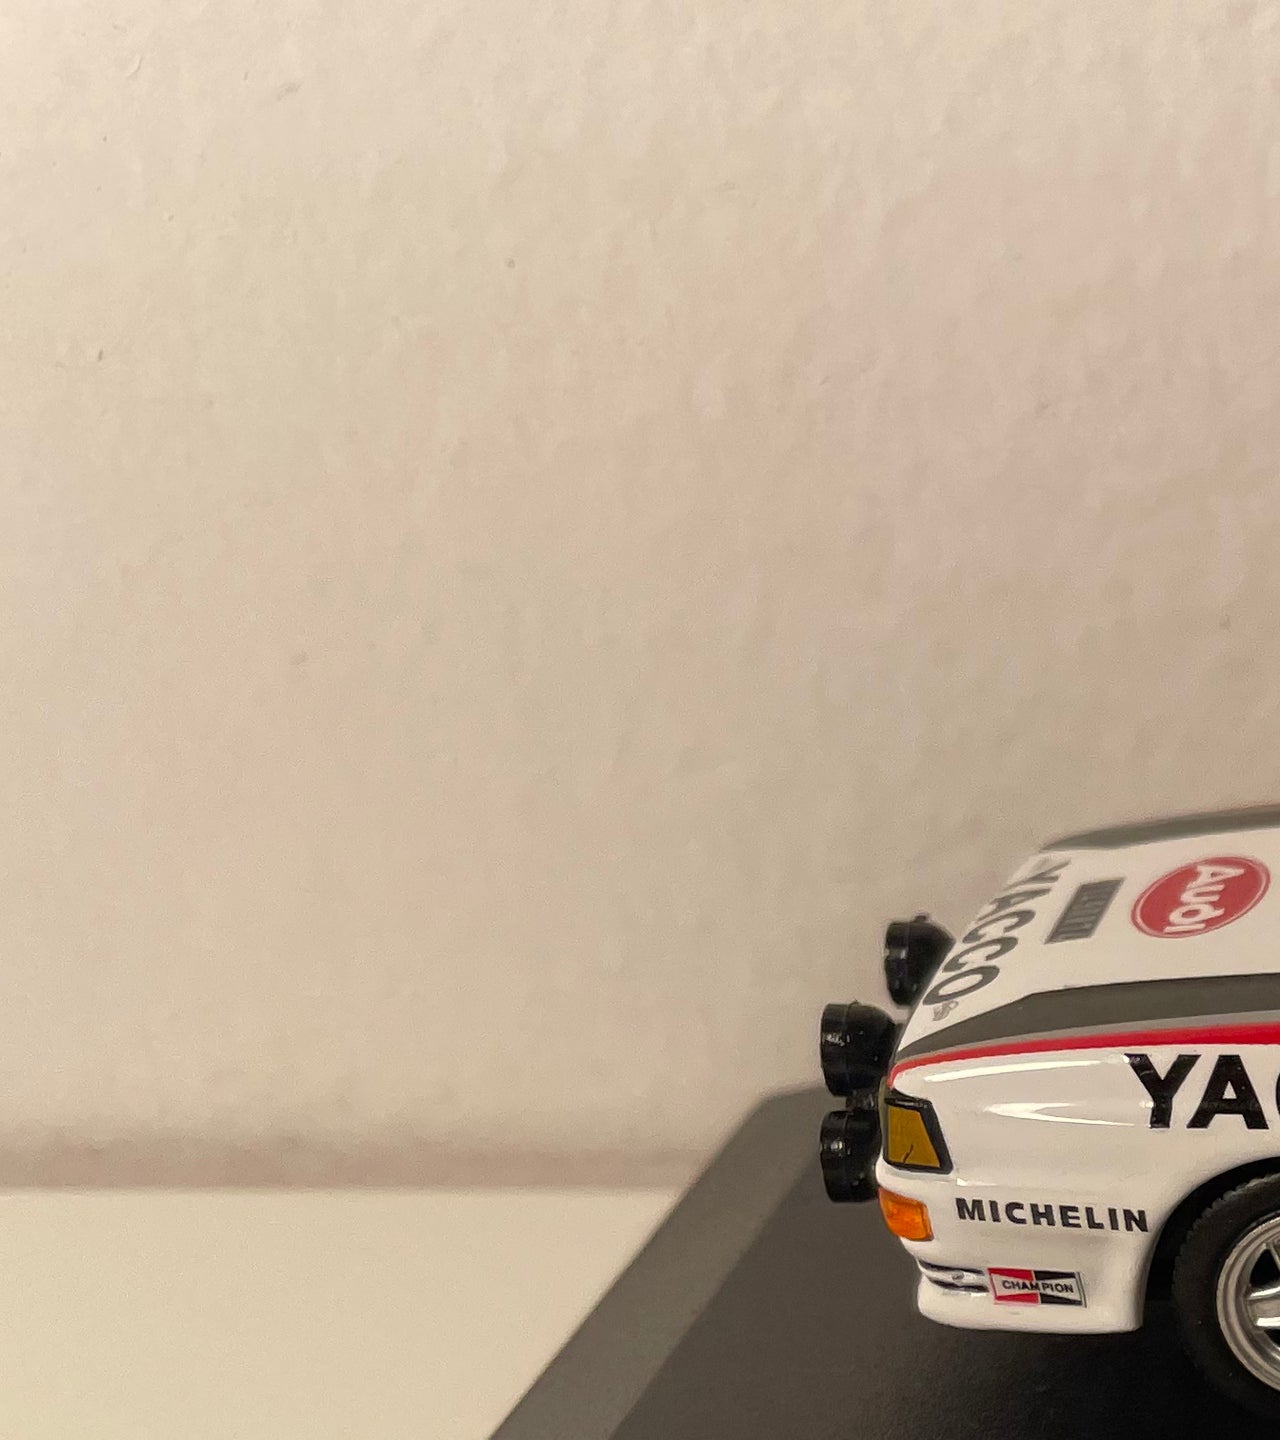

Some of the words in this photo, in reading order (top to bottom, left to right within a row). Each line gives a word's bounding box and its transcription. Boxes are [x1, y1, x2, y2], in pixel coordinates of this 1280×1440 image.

[1162, 864, 1245, 934] Audi
[954, 1197, 1149, 1233] MICHELIN
[1001, 1279, 1075, 1294] CHAMPION
